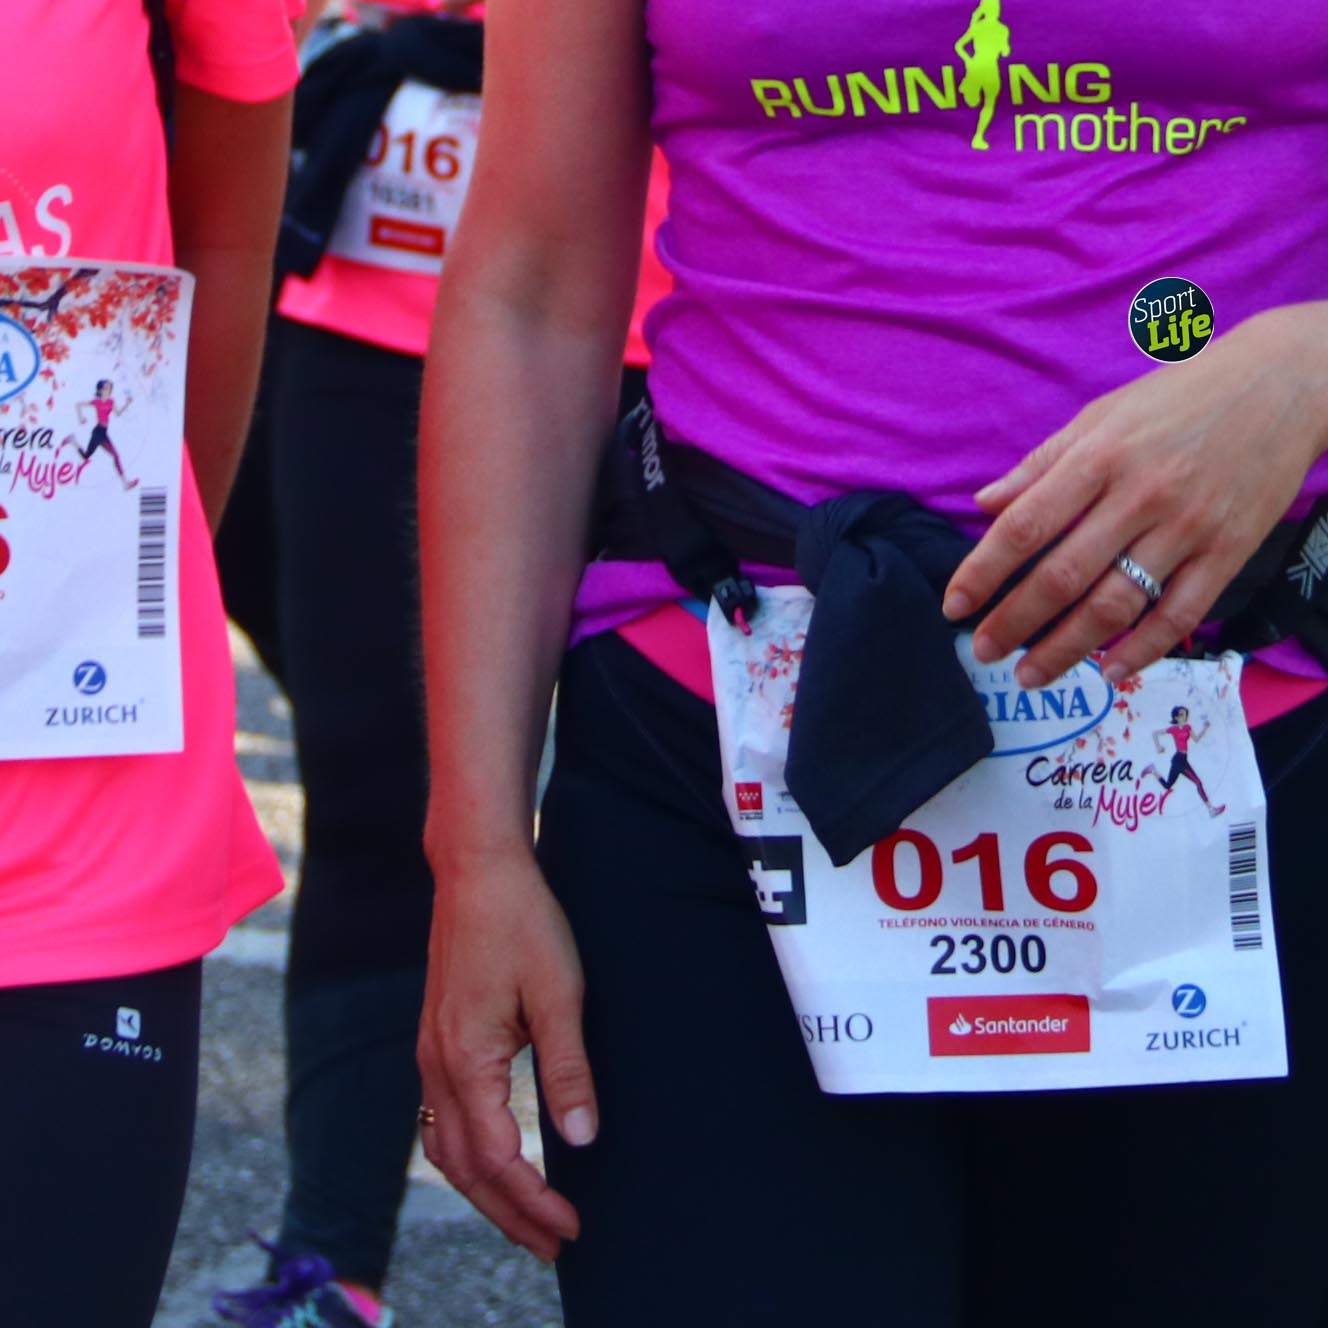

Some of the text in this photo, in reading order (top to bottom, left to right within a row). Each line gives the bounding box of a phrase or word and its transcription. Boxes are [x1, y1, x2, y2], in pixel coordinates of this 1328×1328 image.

[1133, 286, 1197, 323] Sport
[1146, 309, 1212, 352] Life
[9, 444, 93, 500] Mujer
[44, 703, 138, 727] ZURICH
[1024, 755, 1134, 787] Carrera
[1053, 777, 1174, 833] de la Mujer
[871, 827, 1099, 913] 016
[878, 917, 1095, 931] TELÉFONO VIOLENCIA DE GÉNERO
[929, 934, 1047, 975] 2300
[798, 1010, 873, 1043] SHO
[974, 1015, 1069, 1036] Santander
[1145, 1027, 1240, 1051] ZURICH
